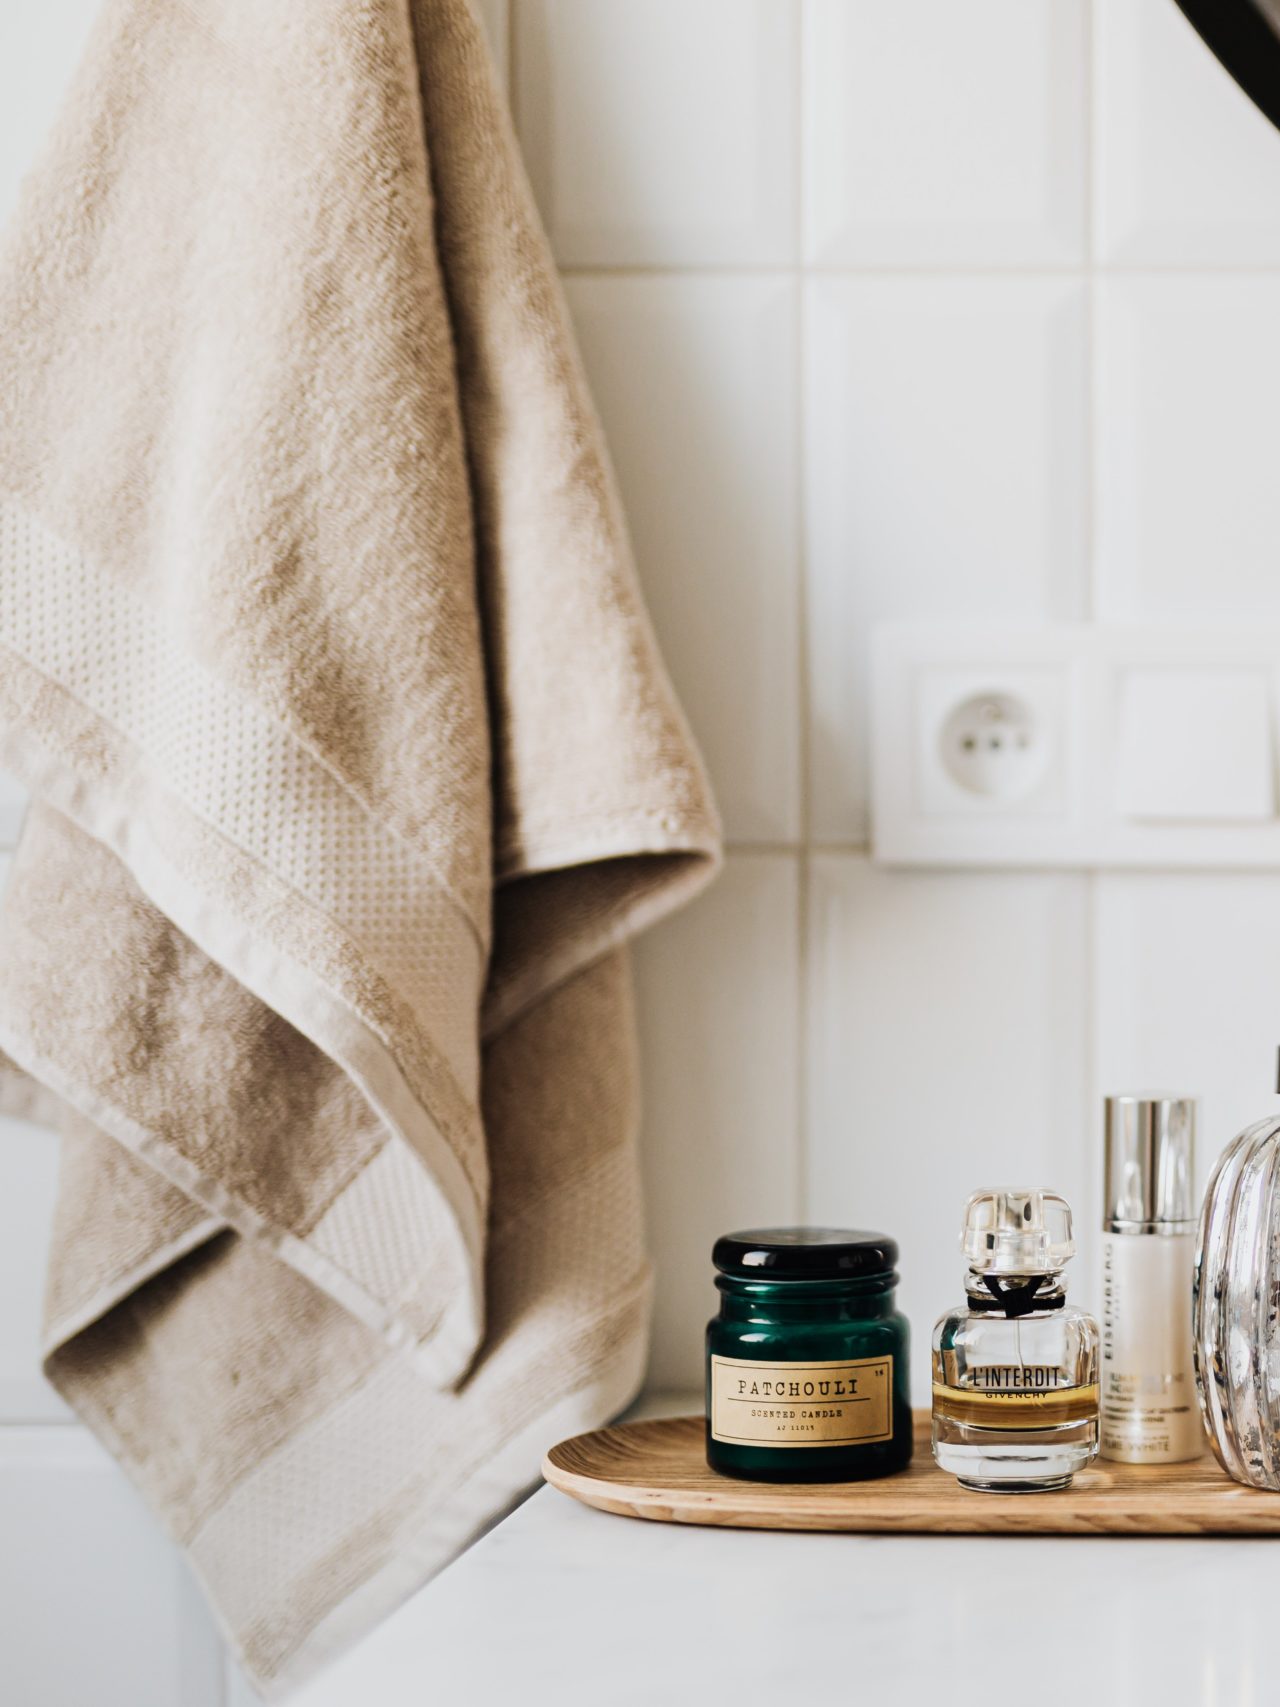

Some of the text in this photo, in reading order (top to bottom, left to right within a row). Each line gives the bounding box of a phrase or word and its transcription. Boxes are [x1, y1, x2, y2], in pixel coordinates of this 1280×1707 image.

[973, 1367, 1060, 1387] L'INTERDIT
[738, 1378, 858, 1397] PATCHOULI
[985, 1391, 1048, 1399] GIVENCHY
[751, 1409, 843, 1419] SCENTED CANDLE
